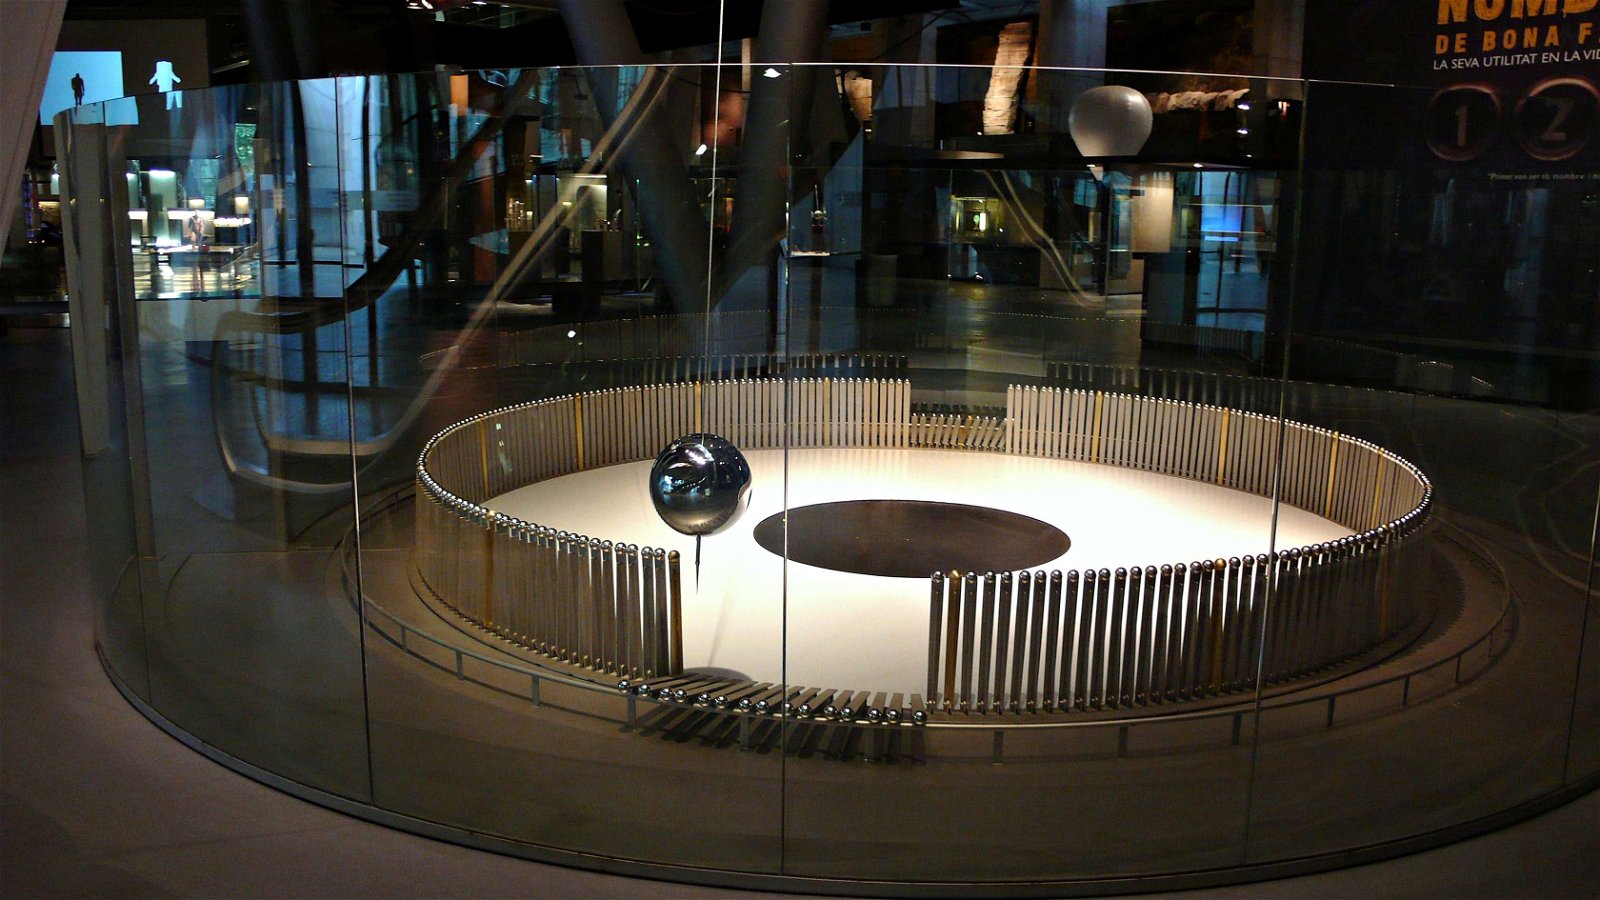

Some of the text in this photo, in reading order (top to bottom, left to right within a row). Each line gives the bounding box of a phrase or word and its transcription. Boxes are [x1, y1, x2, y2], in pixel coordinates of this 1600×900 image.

[1435, 21, 1600, 55] DE BONA F
[1433, 60, 1448, 70] LA
[1451, 57, 1479, 69] SEVA
[1483, 53, 1538, 67] UTILITAT
[1541, 51, 1560, 63] EN
[1564, 50, 1581, 62] LA
[1456, 99, 1575, 147] 1 2
